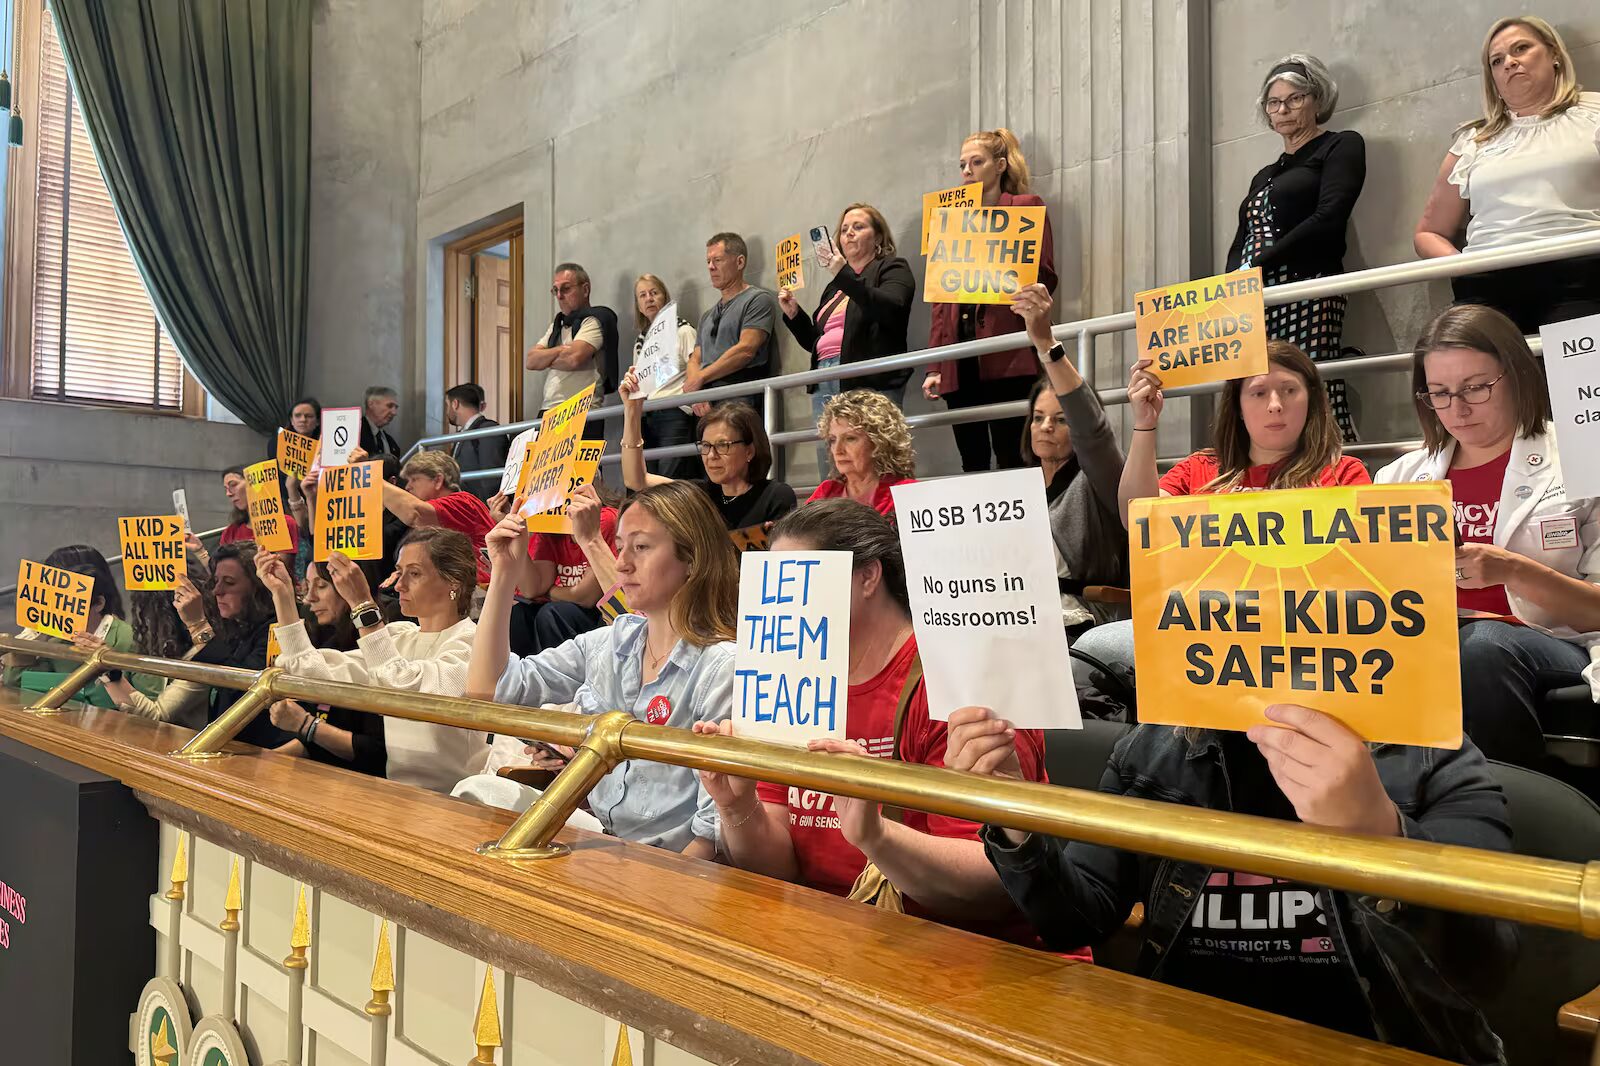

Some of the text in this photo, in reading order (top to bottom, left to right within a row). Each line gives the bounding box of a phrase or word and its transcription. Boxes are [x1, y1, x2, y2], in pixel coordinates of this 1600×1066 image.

[938, 188, 967, 204] WE'RE
[939, 210, 949, 233] 1
[961, 209, 1010, 233] KID
[780, 240, 792, 256] KID
[786, 253, 800, 269] THE
[930, 239, 1037, 264] ALL THE
[940, 269, 1019, 294] GUNS
[1137, 277, 1260, 316] 1 YEAR LATER
[1147, 313, 1253, 350] ARE KIDS
[1158, 339, 1242, 371] SAFER?
[1562, 336, 1596, 356] NO
[548, 408, 567, 432] YEAR
[567, 393, 592, 421] LATER
[1574, 409, 1600, 425] cla
[283, 430, 313, 451] WE'RE
[285, 445, 308, 463] STILL
[531, 446, 552, 473] ARE
[551, 433, 576, 464] KIDS
[257, 467, 278, 484] LATER
[325, 464, 371, 494] WE'RE
[527, 463, 564, 496] SAFER?
[259, 497, 279, 516] KIDS
[327, 495, 366, 522] STILL
[910, 499, 1026, 531] NO SB 1325
[123, 519, 130, 537] 1
[136, 518, 164, 537] KID
[326, 524, 366, 550] HERE
[1135, 504, 1450, 549] 1 YEAR LATER
[124, 540, 183, 560] ALL THE
[26, 562, 32, 580] 1
[40, 566, 71, 589] KID
[132, 563, 176, 583] GUNS
[761, 559, 821, 606] LET
[923, 572, 1025, 599] No guns in
[19, 583, 87, 616] ALL THE
[1157, 589, 1426, 637] ARE KIDS
[27, 606, 74, 635] GUNS
[923, 605, 1038, 627] classrooms!
[744, 614, 829, 661] THEM
[1185, 642, 1395, 695] SAFER?
[735, 669, 837, 731] TEACH
[0, 880, 26, 924] INESS
[1205, 939, 1271, 952] DISTRICT
[1273, 939, 1292, 951] 75
